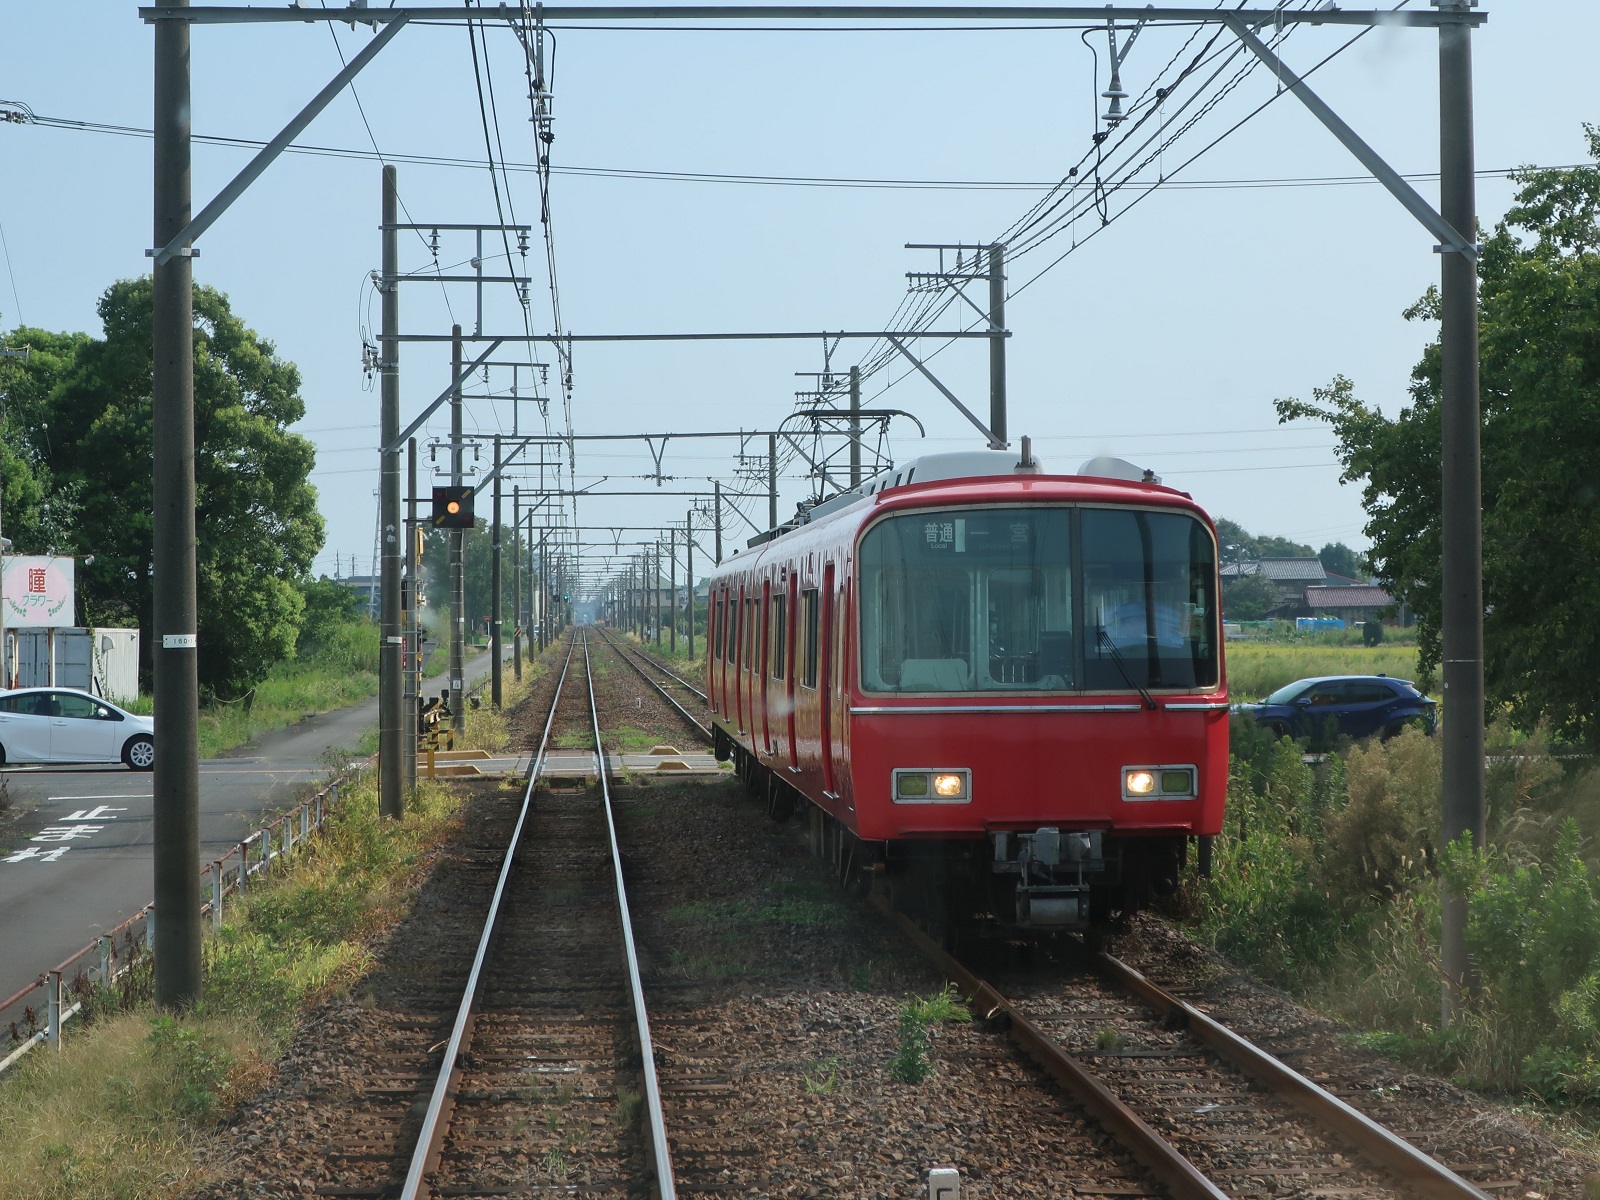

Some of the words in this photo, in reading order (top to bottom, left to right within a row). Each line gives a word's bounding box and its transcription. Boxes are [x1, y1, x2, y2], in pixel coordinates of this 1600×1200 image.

[925, 523, 953, 543] 普通
[29, 568, 47, 593] 瞳
[22, 595, 54, 607] フラワー
[0, 805, 128, 864] 止まれ
